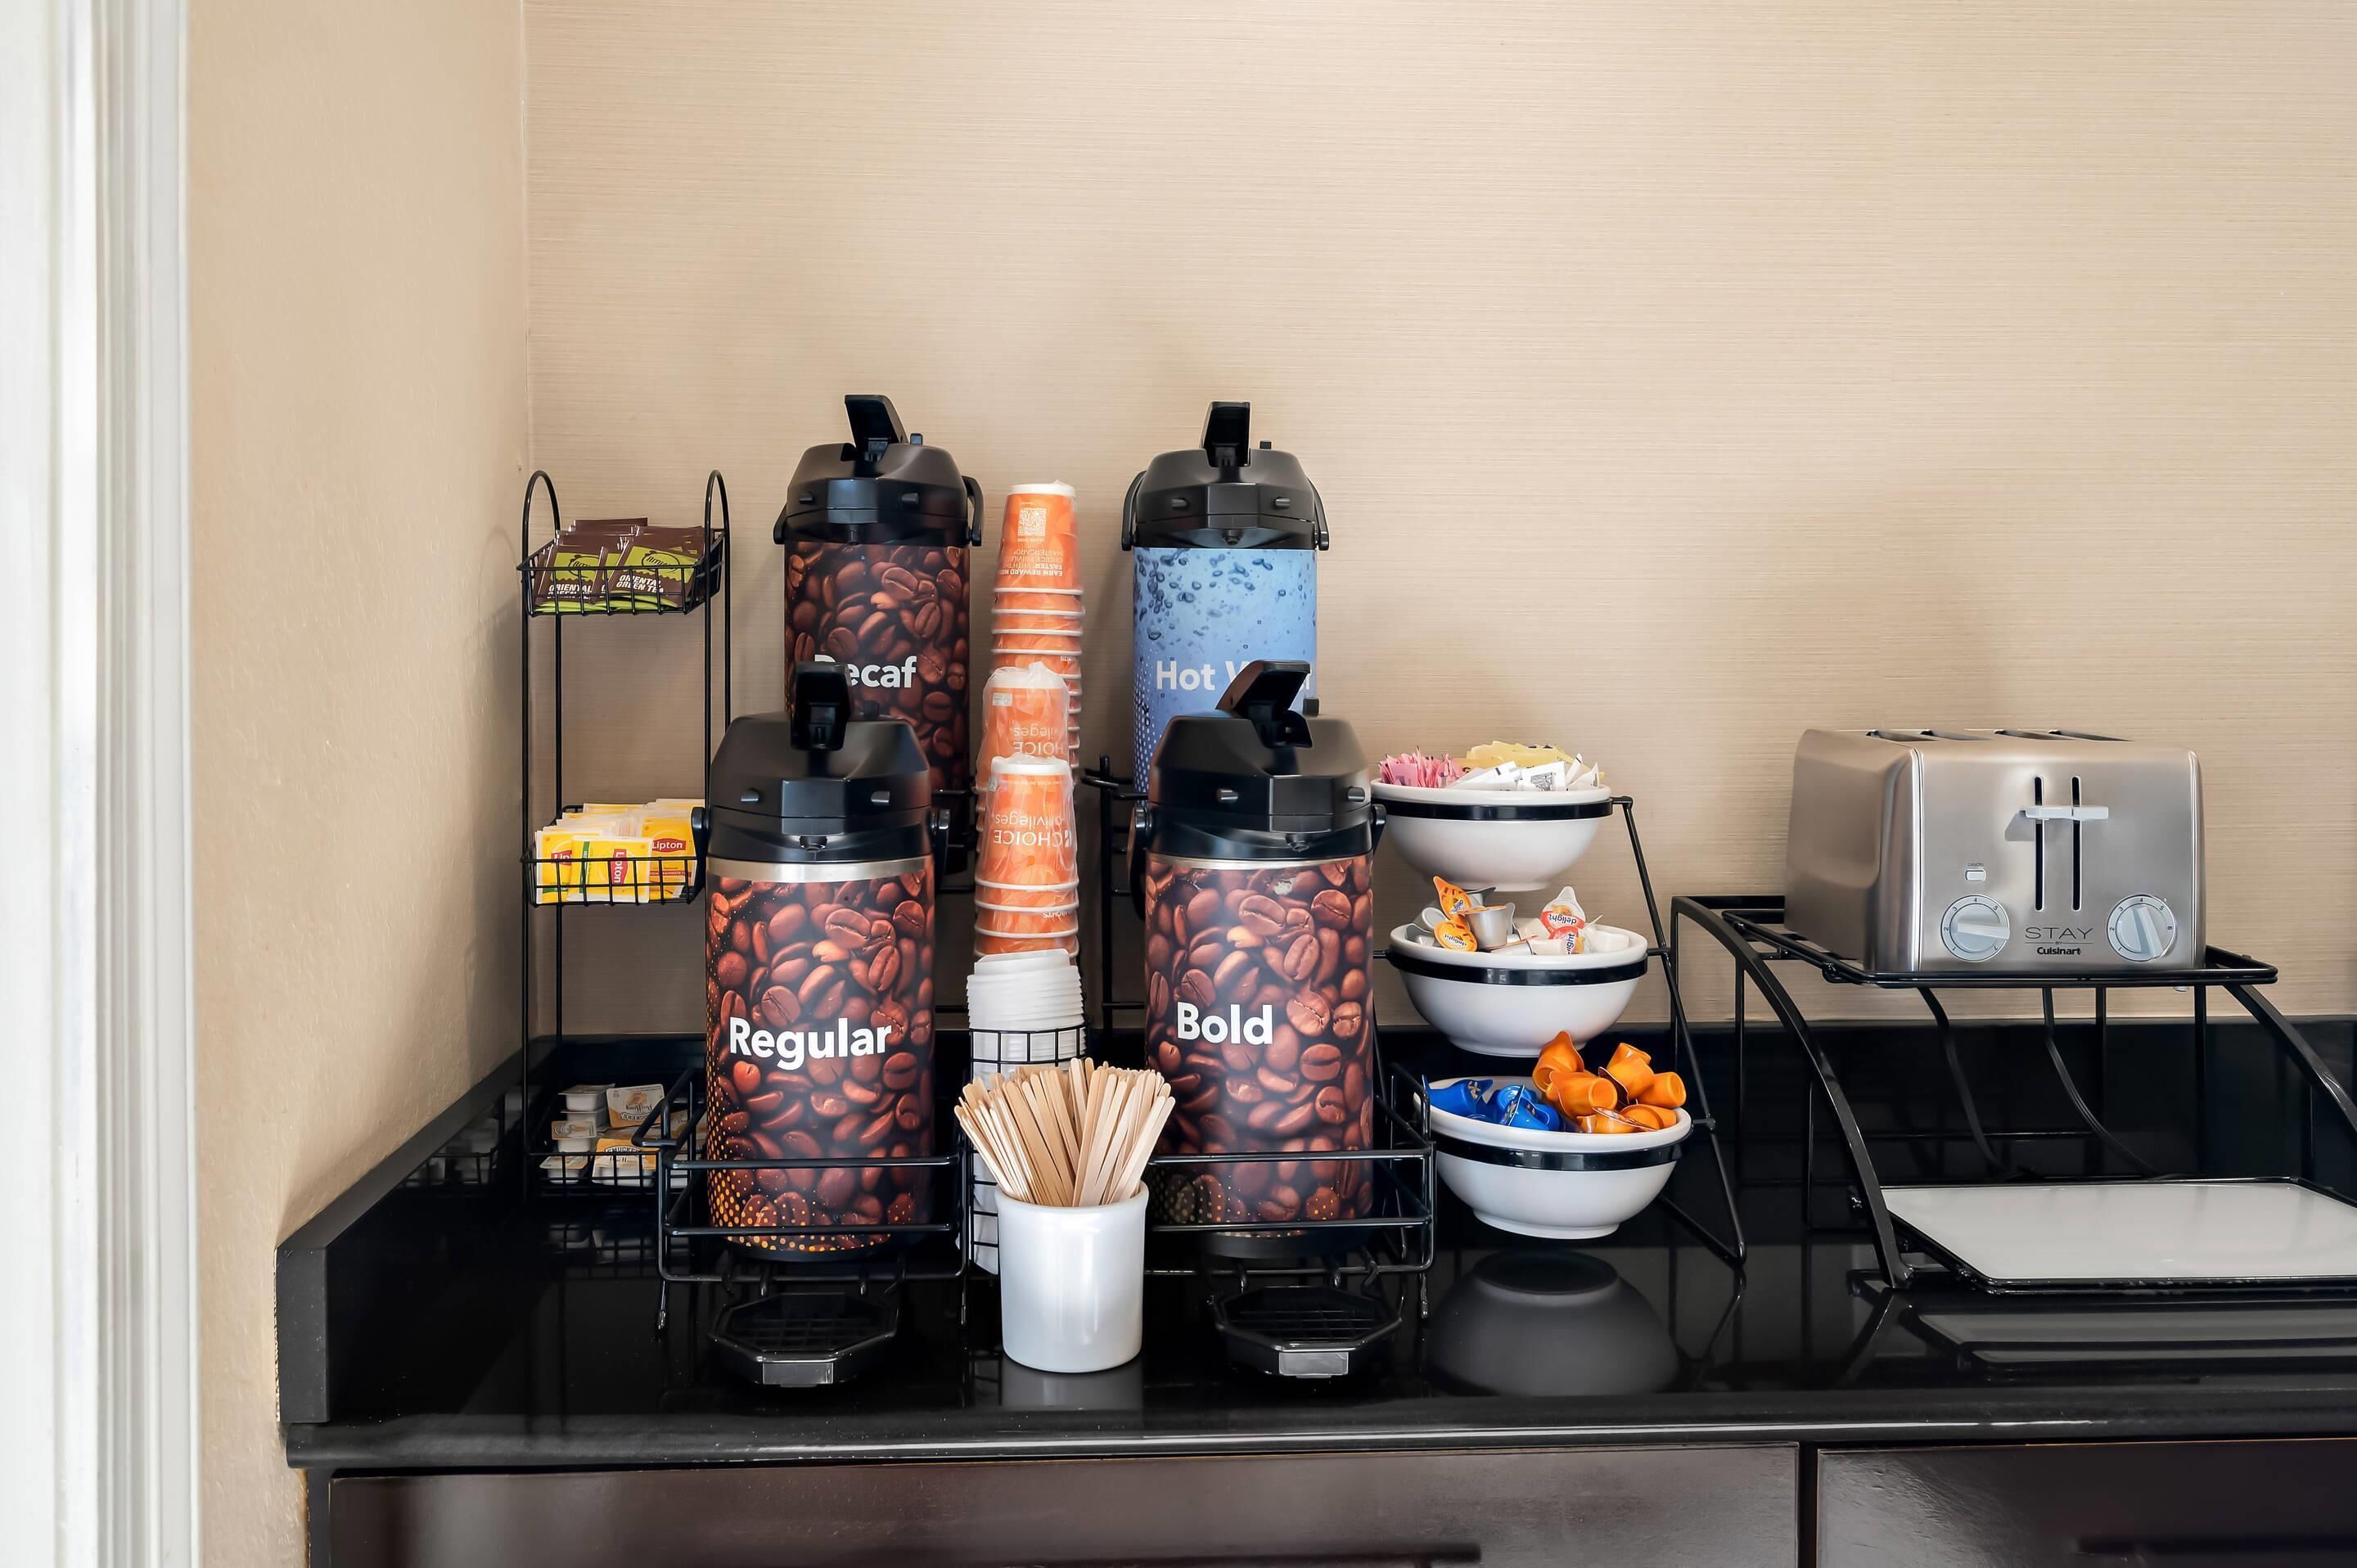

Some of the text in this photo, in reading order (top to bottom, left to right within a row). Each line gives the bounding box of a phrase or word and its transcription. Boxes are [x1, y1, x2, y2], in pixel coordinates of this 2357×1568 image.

[814, 655, 917, 688] ecaf
[1156, 661, 1215, 691] Hot
[995, 811, 1062, 830] privileges
[652, 840, 683, 852] Lipton
[994, 829, 1063, 847] CHOICE
[1548, 914, 1577, 926] delight
[2025, 926, 2093, 939] STAY
[2037, 947, 2080, 955] Cuisinart
[1177, 1002, 1273, 1045] Bold
[729, 1017, 892, 1070] Regular
